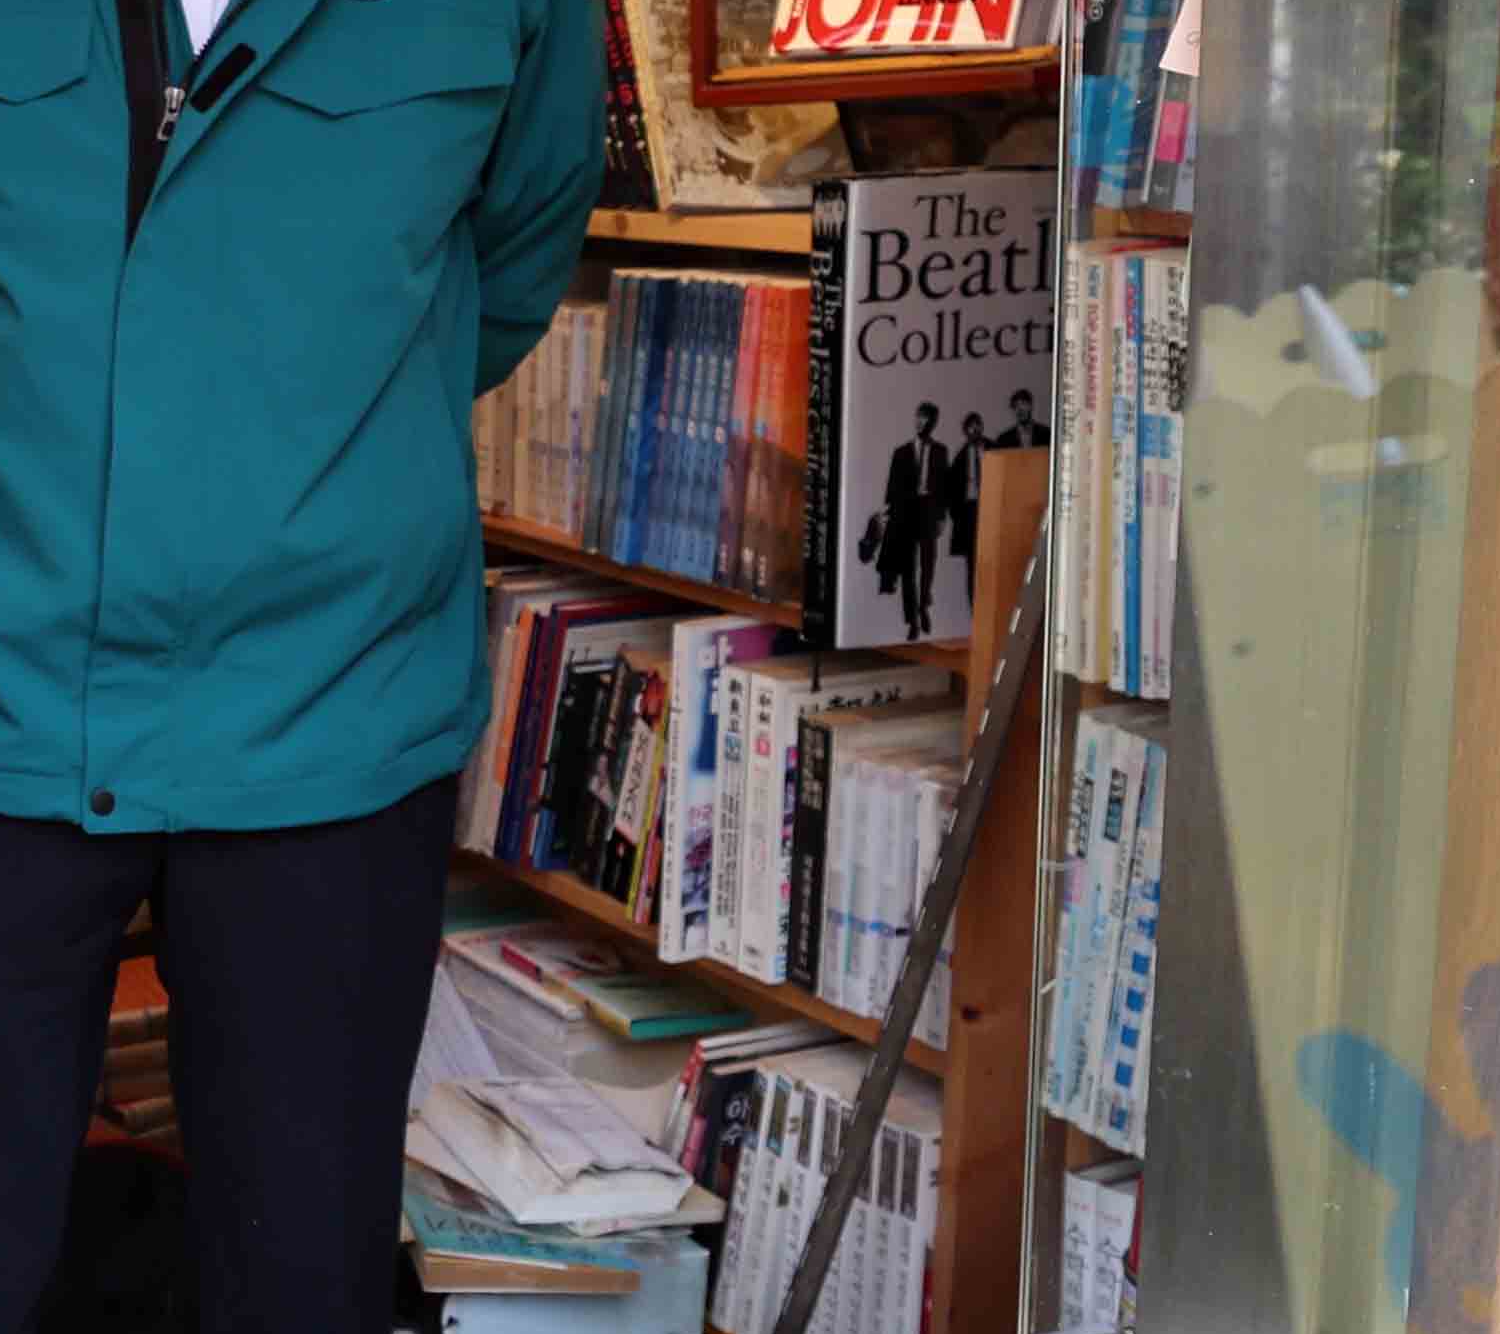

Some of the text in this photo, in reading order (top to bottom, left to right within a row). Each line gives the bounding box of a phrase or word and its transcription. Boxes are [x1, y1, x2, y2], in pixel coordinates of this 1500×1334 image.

[914, 192, 1008, 240] The
[858, 217, 1053, 305] Beatl
[806, 248, 834, 400] Beatles
[823, 276, 843, 331] The
[857, 307, 1055, 367] Collecti
